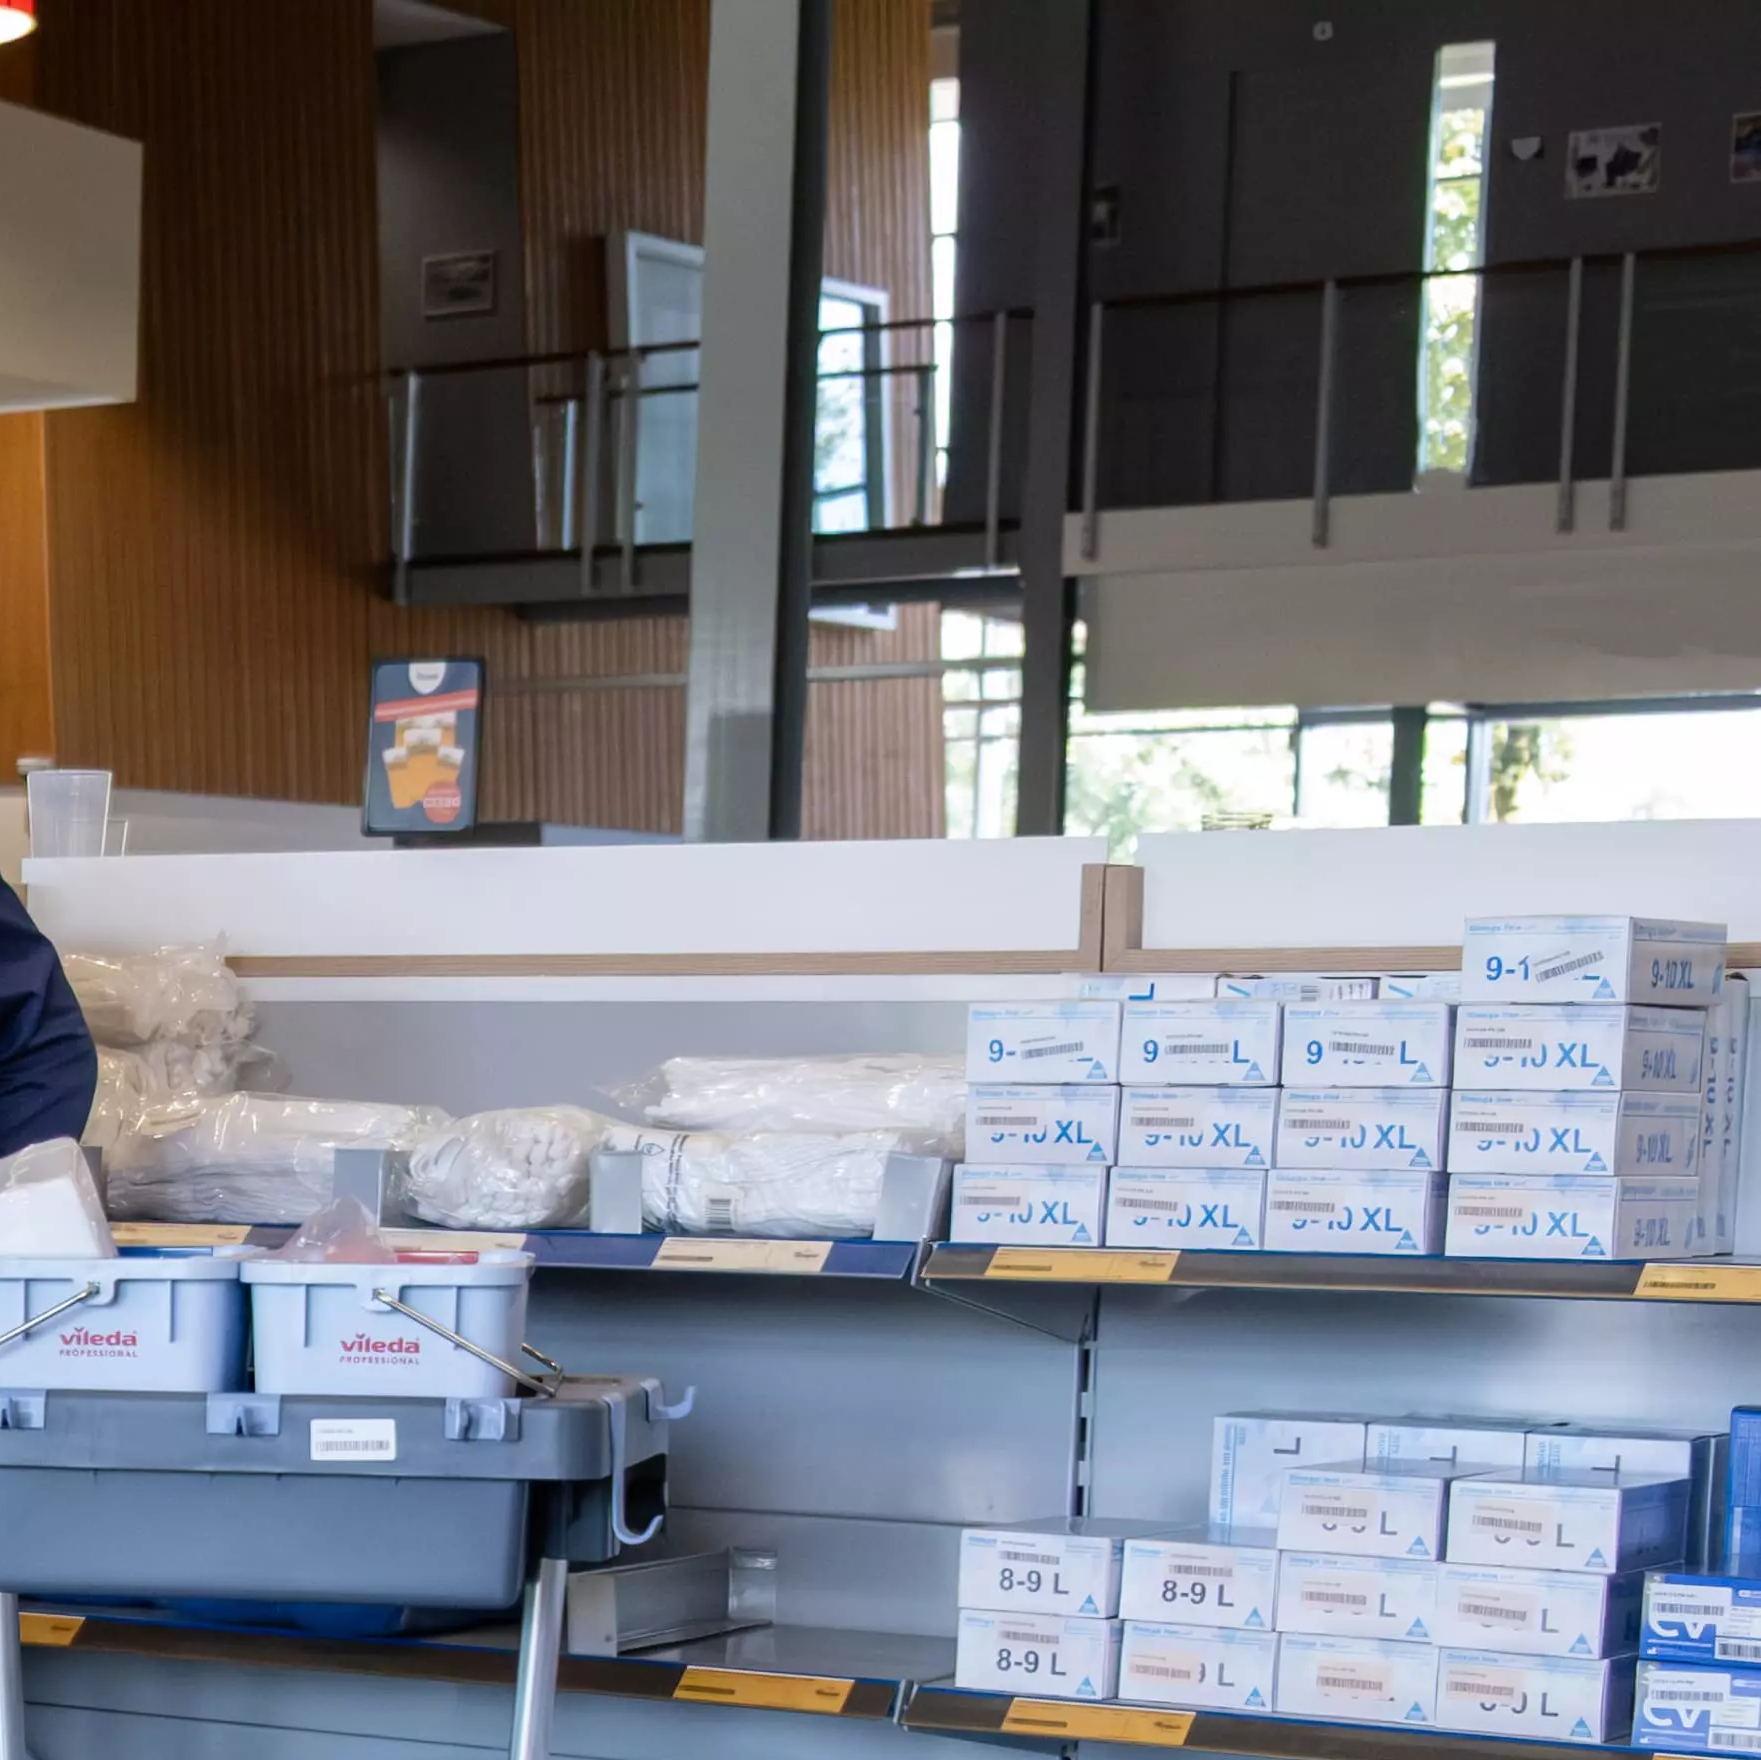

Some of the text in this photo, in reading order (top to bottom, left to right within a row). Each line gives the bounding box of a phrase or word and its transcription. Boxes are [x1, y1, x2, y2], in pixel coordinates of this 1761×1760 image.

[1486, 955, 1530, 981] 9-1
[1555, 1043, 1600, 1068] XL
[1054, 1120, 1093, 1144] XL
[1211, 1123, 1251, 1147] XL
[1373, 1125, 1417, 1149] XL
[1548, 1128, 1592, 1153] XL
[1039, 1201, 1079, 1225] XL
[1199, 1204, 1239, 1228] XL
[1359, 1207, 1403, 1231] XL
[1546, 1212, 1589, 1237] XL
[60, 1327, 138, 1346] vileda
[340, 1333, 421, 1354] vileda
[1380, 1511, 1398, 1535] L
[1556, 1523, 1575, 1548] L
[999, 1568, 1070, 1595] 8-9 L
[1161, 1580, 1235, 1607] 8-9 L
[1379, 1593, 1397, 1617] L
[1541, 1608, 1559, 1633] L
[996, 1648, 1068, 1676] 8-9 L
[1217, 1663, 1235, 1686] L
[1541, 1692, 1559, 1717] L
